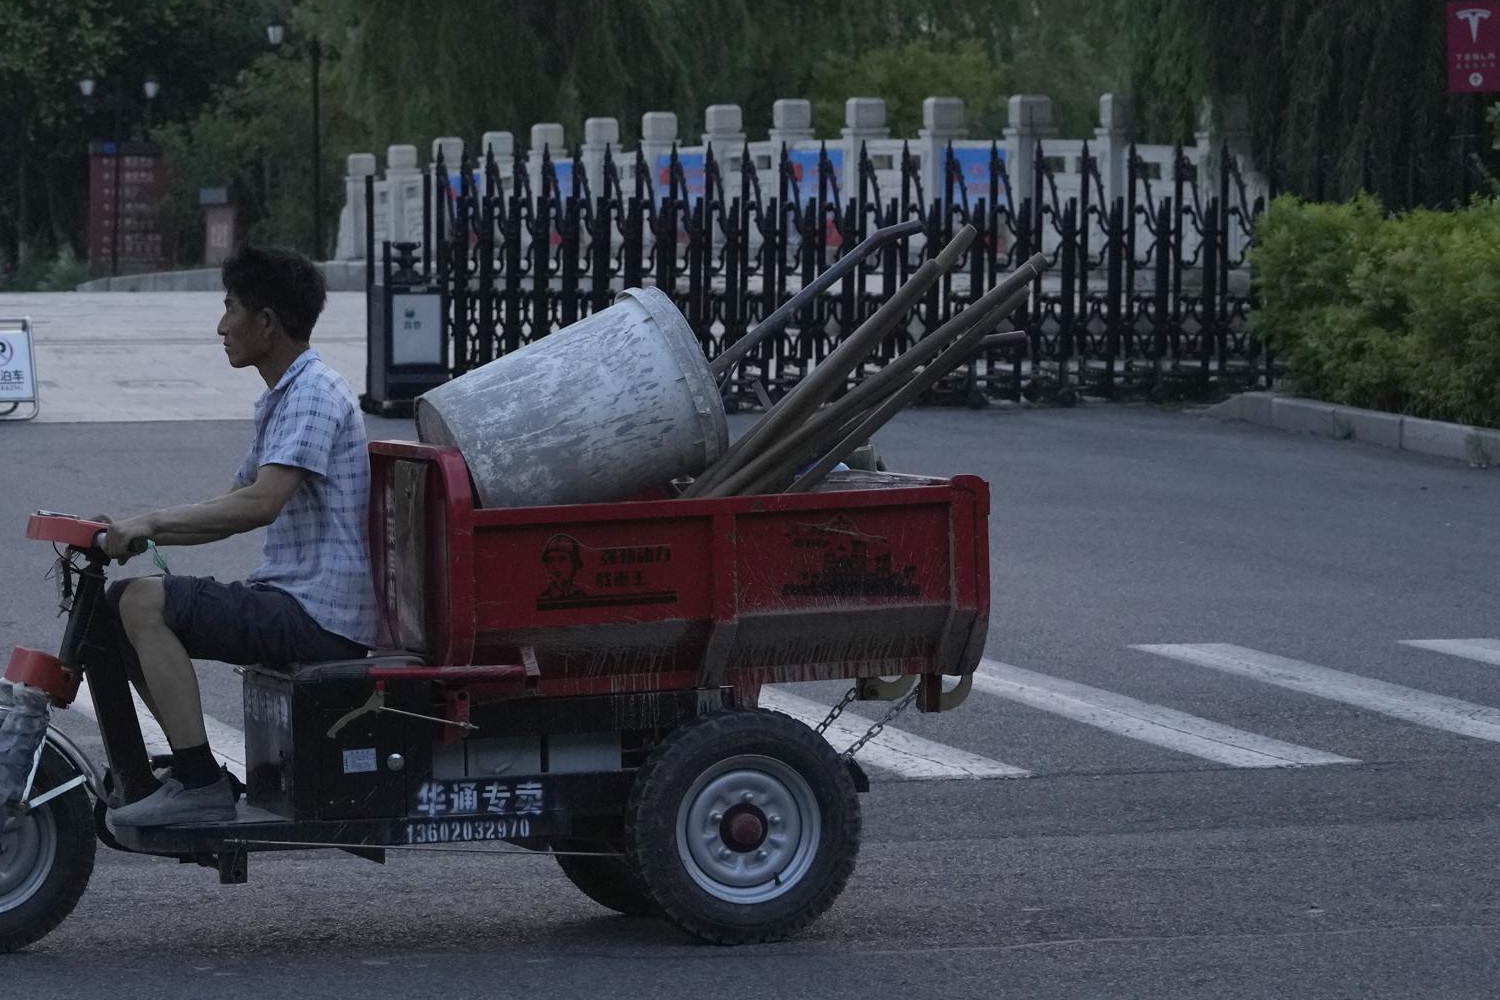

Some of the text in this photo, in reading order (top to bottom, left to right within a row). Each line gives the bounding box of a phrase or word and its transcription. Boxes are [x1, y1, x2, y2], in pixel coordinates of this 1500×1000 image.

[1456, 52, 1496, 61] TESLA
[417, 781, 543, 817] 华通专卖
[407, 818, 531, 844] 13602032970
